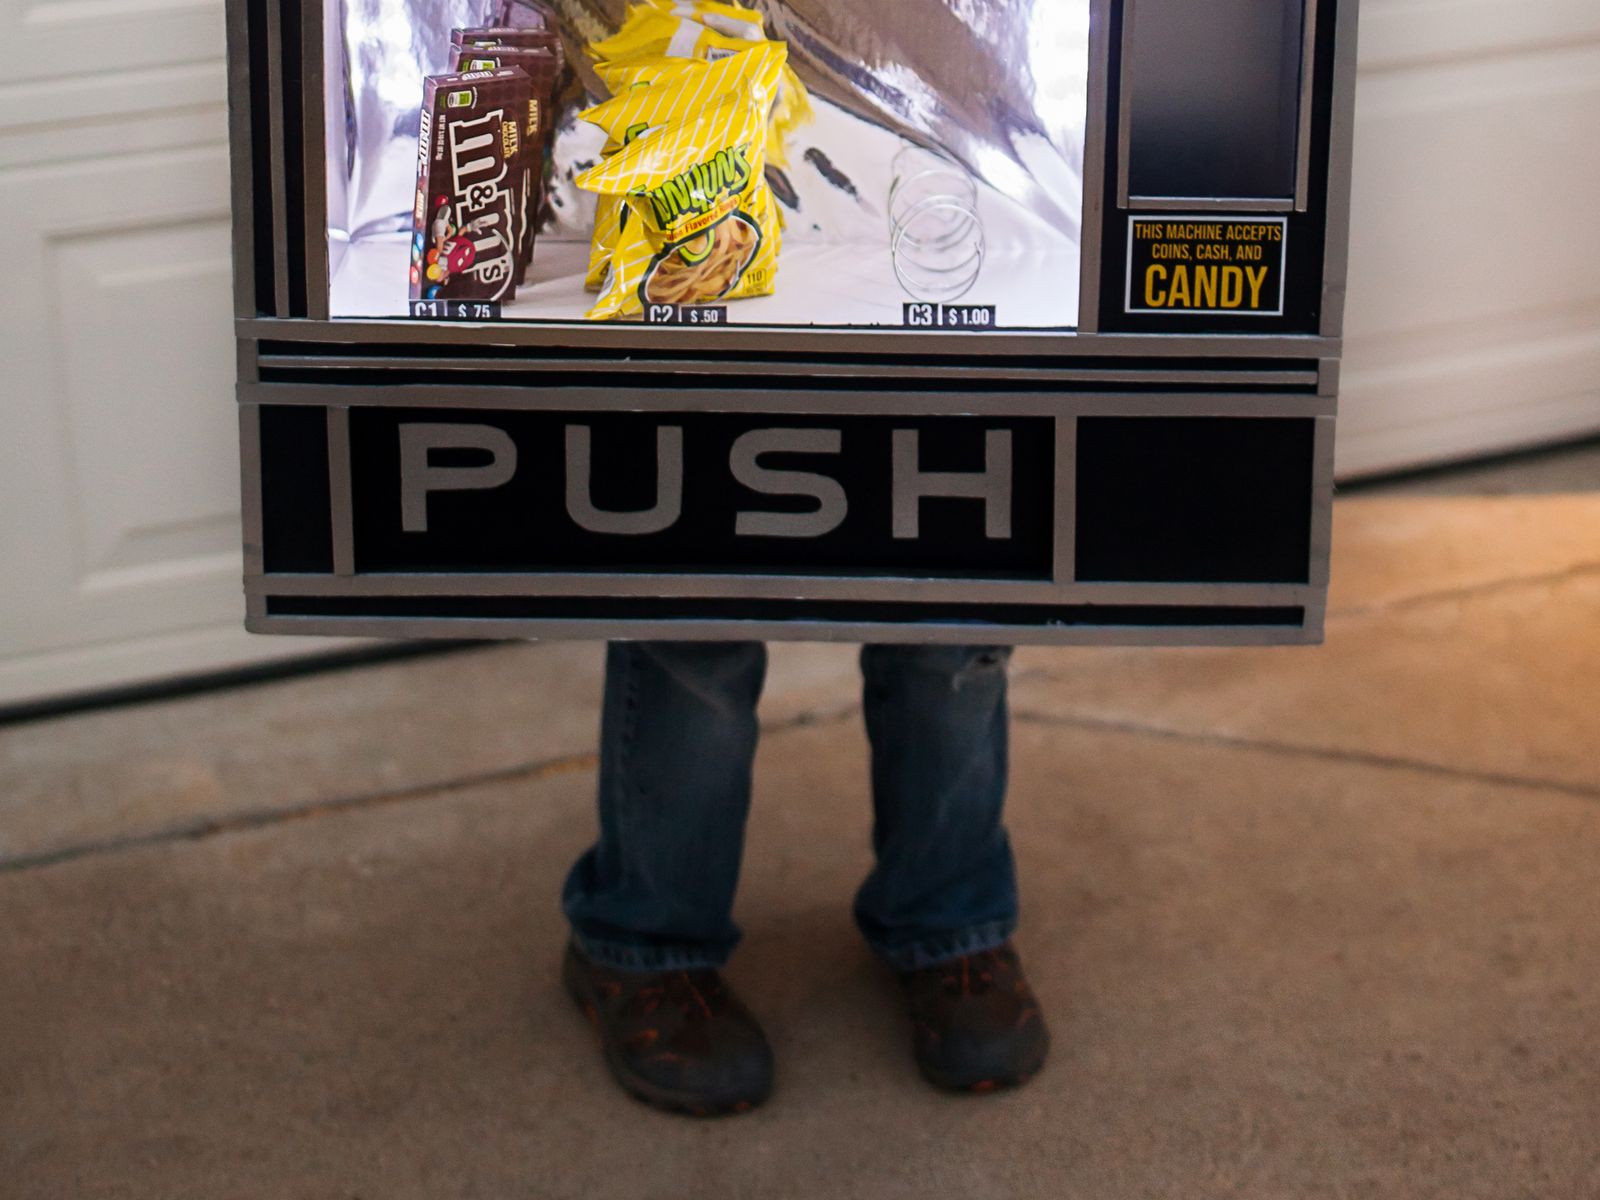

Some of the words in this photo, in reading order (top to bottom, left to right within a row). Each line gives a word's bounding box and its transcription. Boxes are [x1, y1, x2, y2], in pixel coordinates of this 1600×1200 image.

[508, 121, 518, 154] MILK
[1135, 224, 1162, 240] THIS
[1166, 224, 1222, 241] MACHINE
[1225, 225, 1281, 241] ACCEPTS
[1152, 244, 1192, 261] COINS,
[1196, 244, 1232, 261] CASH,
[1236, 244, 1262, 260] AND
[1145, 264, 1268, 308] CANDY
[415, 302, 437, 316] C1
[650, 305, 673, 322] C2
[909, 304, 932, 325] C3
[399, 422, 1012, 539] PUSH
